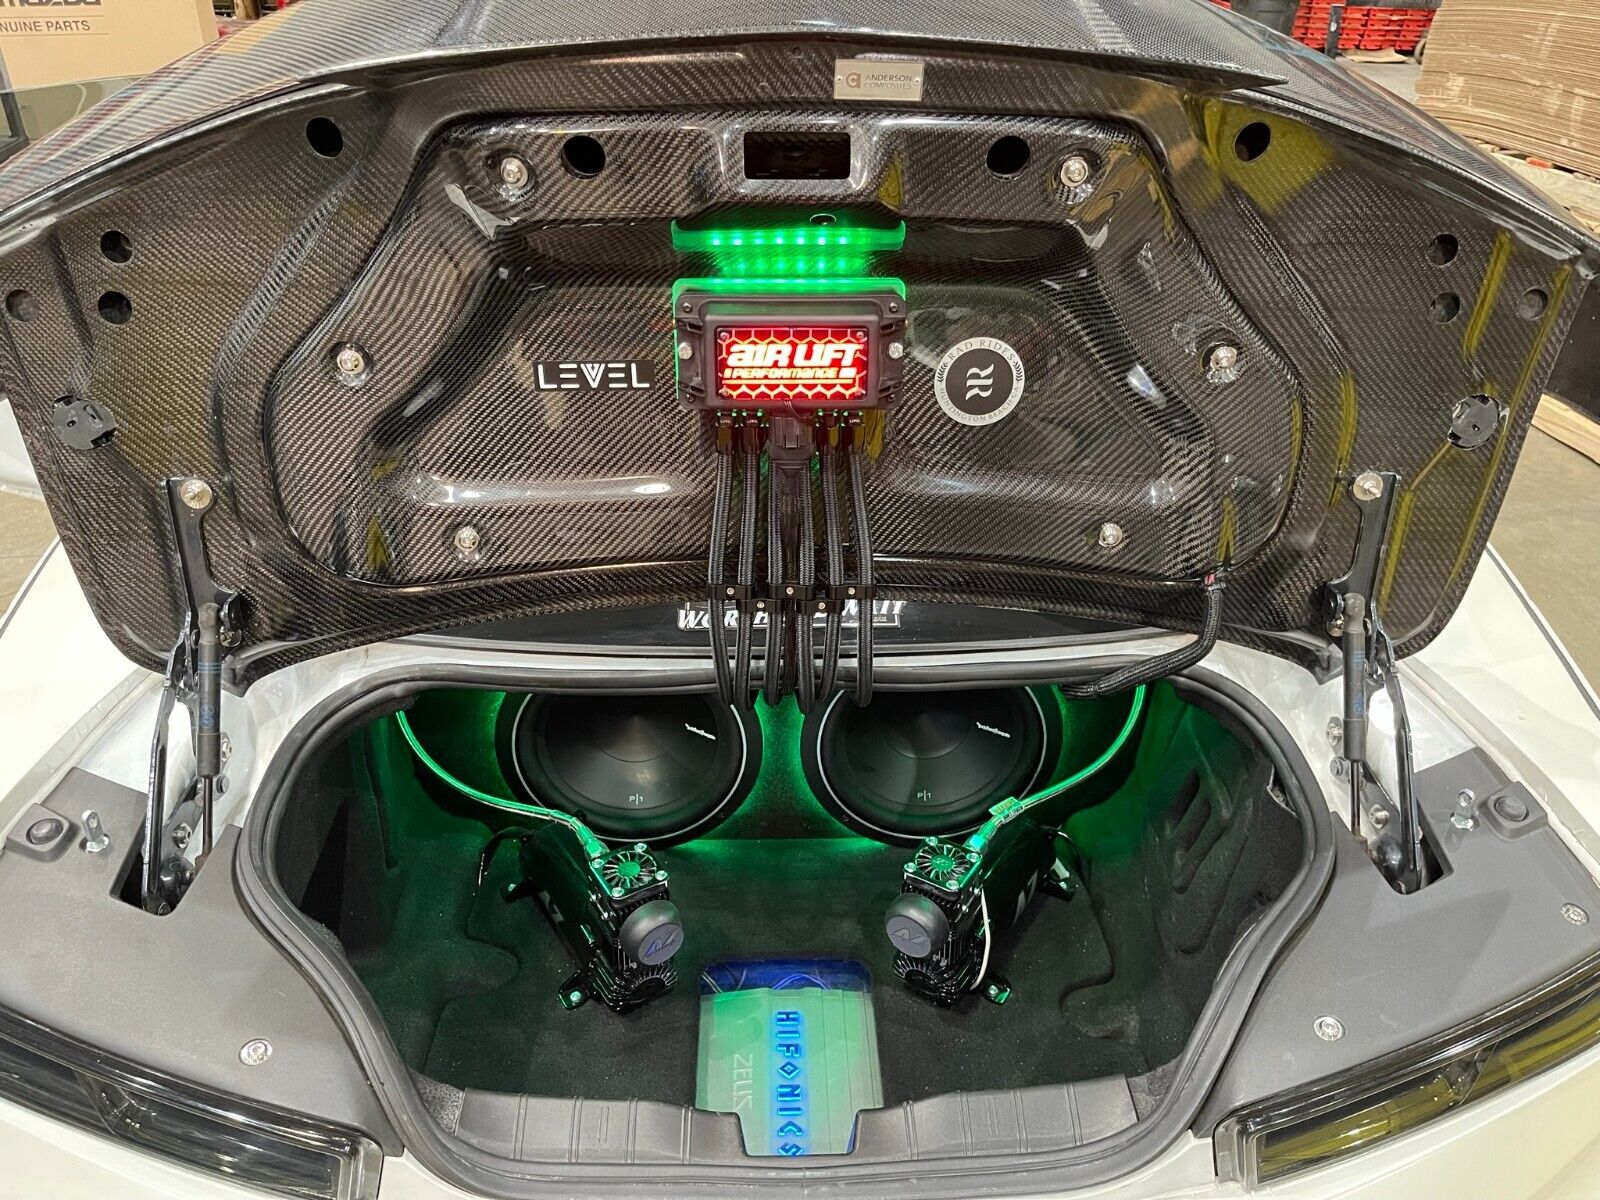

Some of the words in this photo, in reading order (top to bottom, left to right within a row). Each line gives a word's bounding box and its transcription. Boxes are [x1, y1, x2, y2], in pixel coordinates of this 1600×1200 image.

[46, 20, 91, 31] PARTS
[865, 74, 912, 82] ANDERSON
[948, 341, 973, 361] RAD
[980, 340, 1016, 361] RIDES
[537, 362, 651, 389] LEVEL
